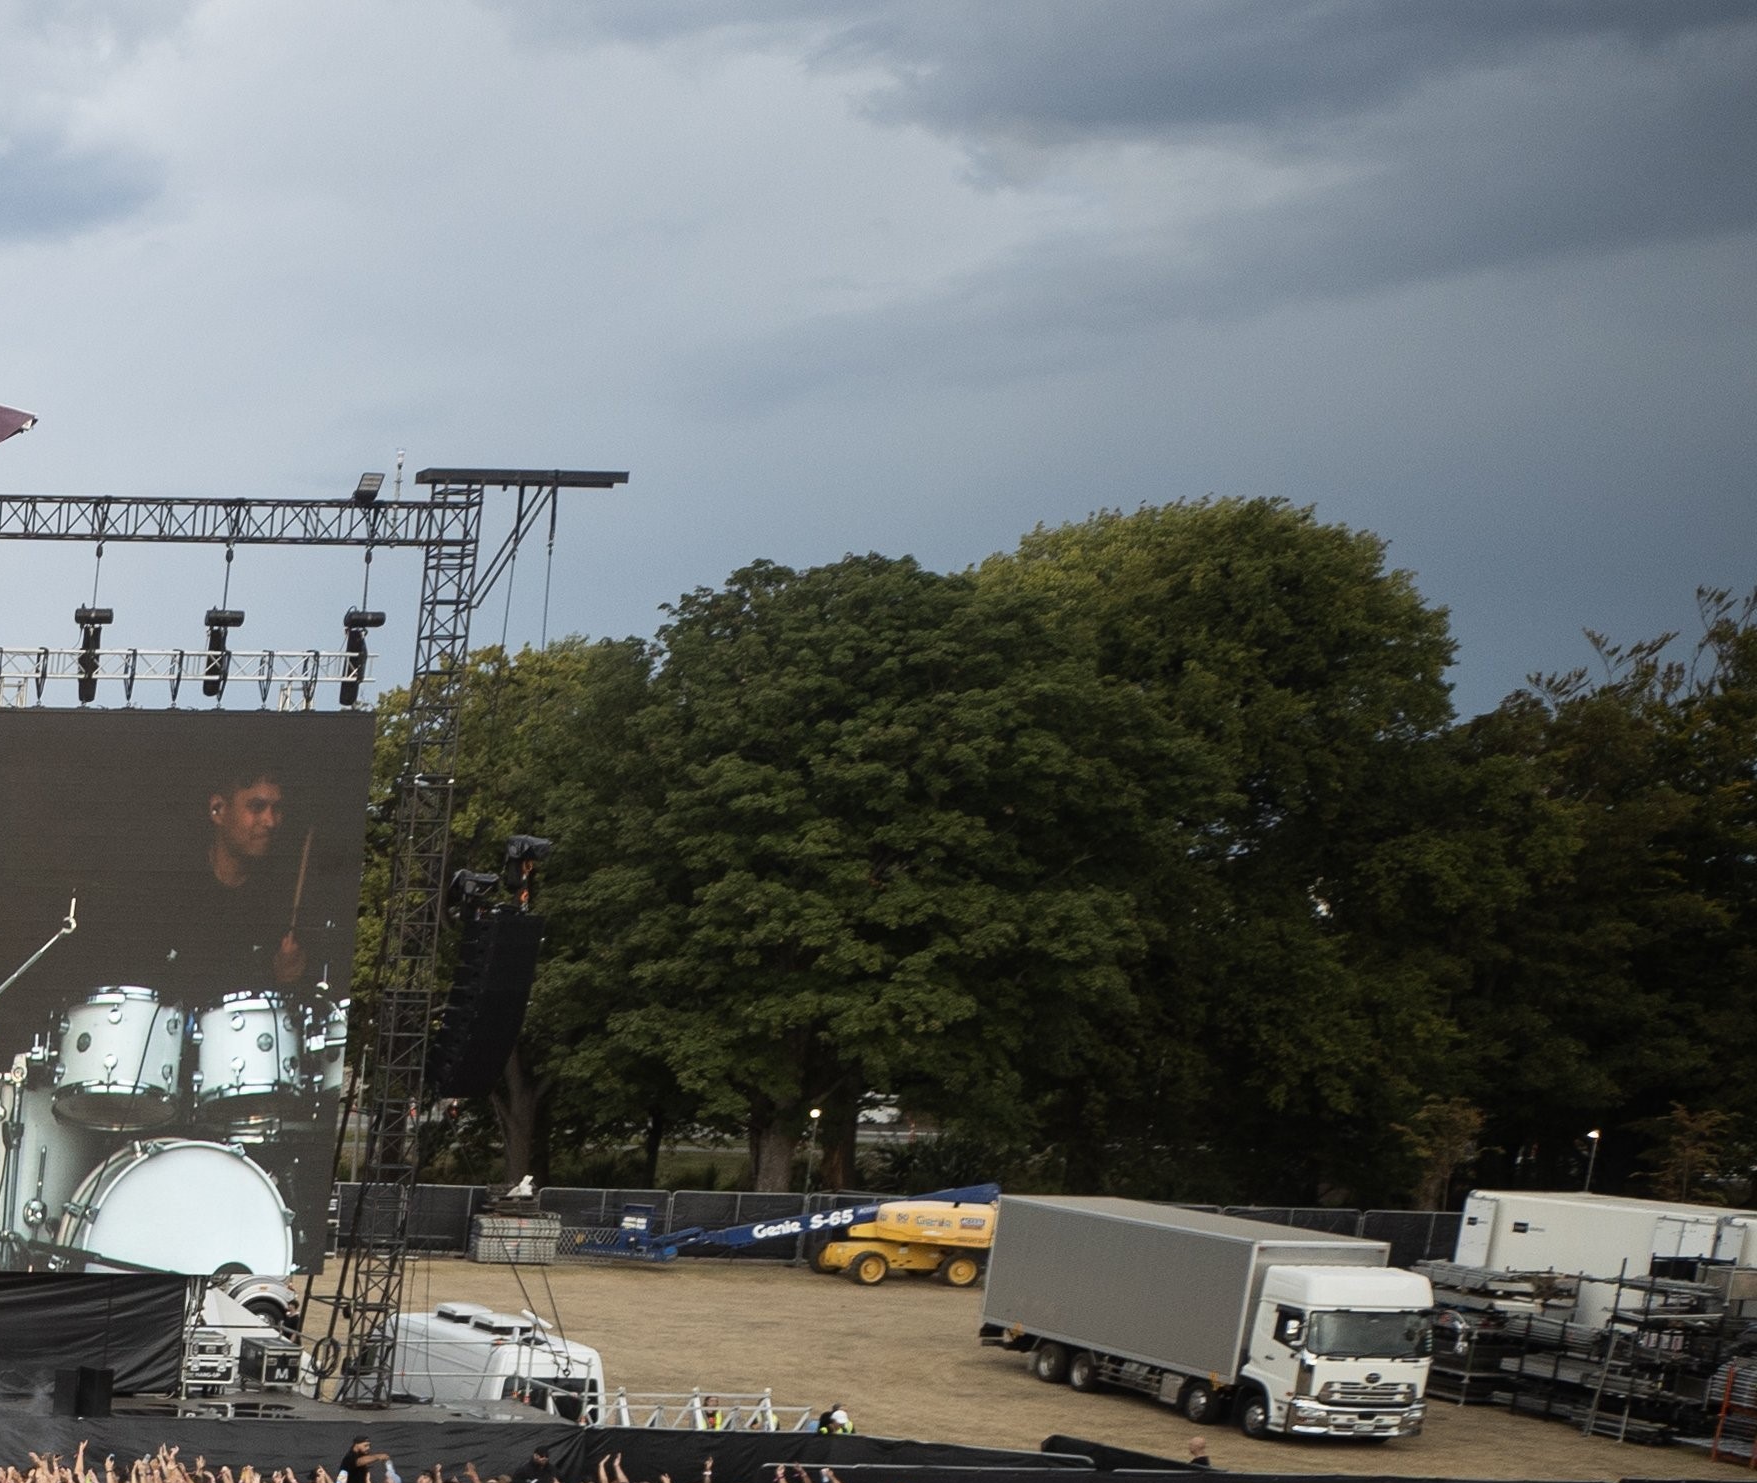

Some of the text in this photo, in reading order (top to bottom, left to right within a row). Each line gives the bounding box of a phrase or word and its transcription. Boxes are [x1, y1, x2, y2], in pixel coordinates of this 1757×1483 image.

[752, 1208, 854, 1239] Genie S-65
[275, 1368, 289, 1379] M
